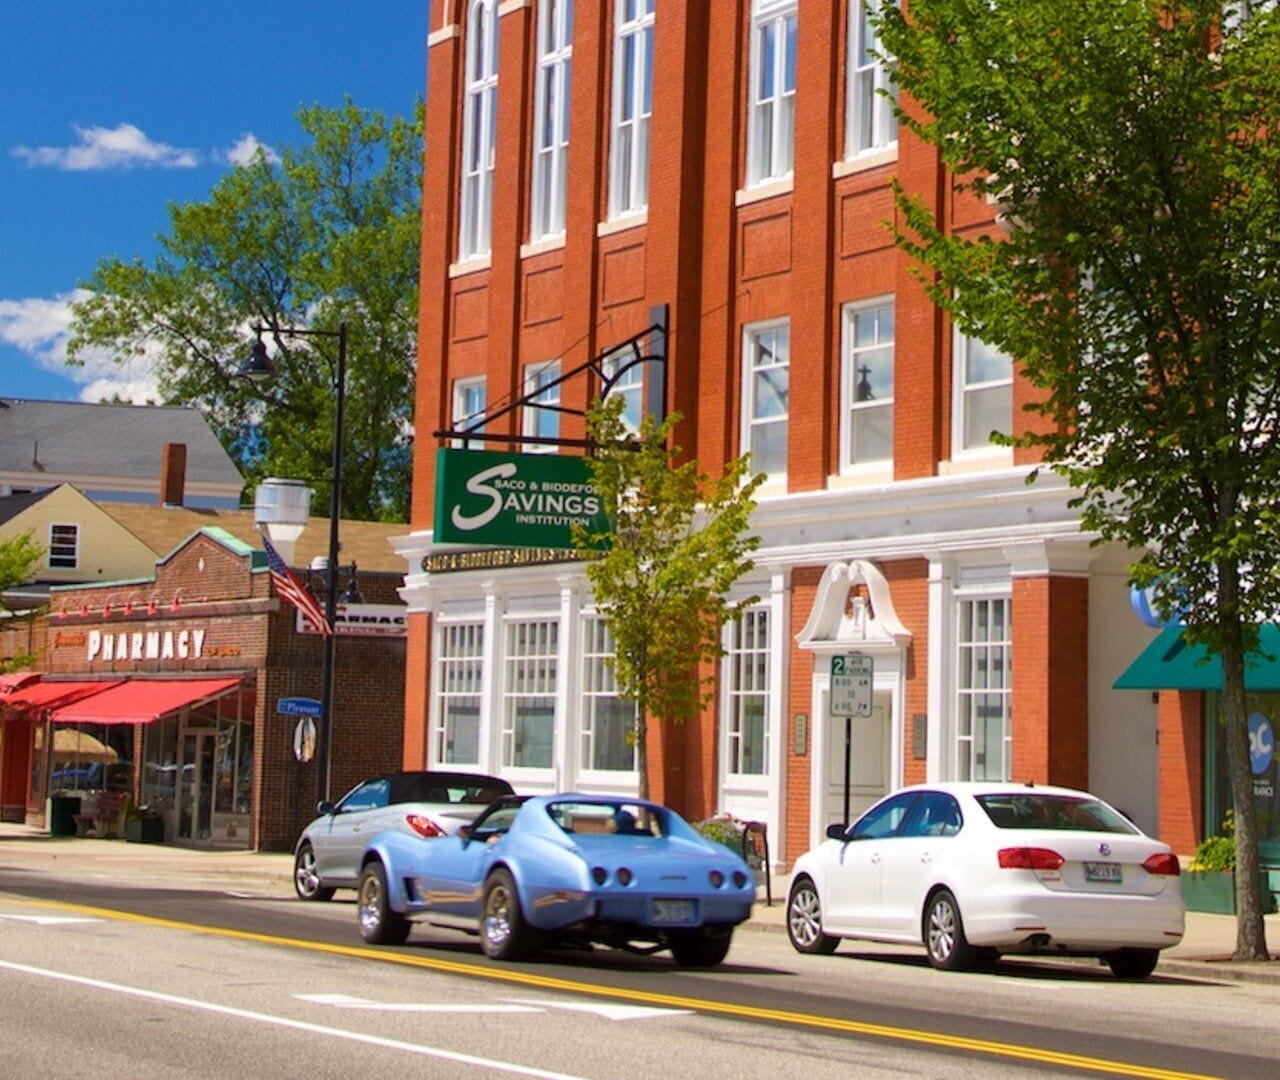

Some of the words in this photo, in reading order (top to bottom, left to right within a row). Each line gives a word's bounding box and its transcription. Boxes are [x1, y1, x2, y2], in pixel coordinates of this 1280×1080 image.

[495, 479, 526, 490] SACO
[529, 480, 538, 490] &
[541, 481, 599, 494] BIDDEFO
[451, 462, 599, 530] SAVINGS
[516, 514, 590, 527] INSTITUTION
[87, 630, 205, 662] PHARMACY
[833, 658, 844, 674] 2
